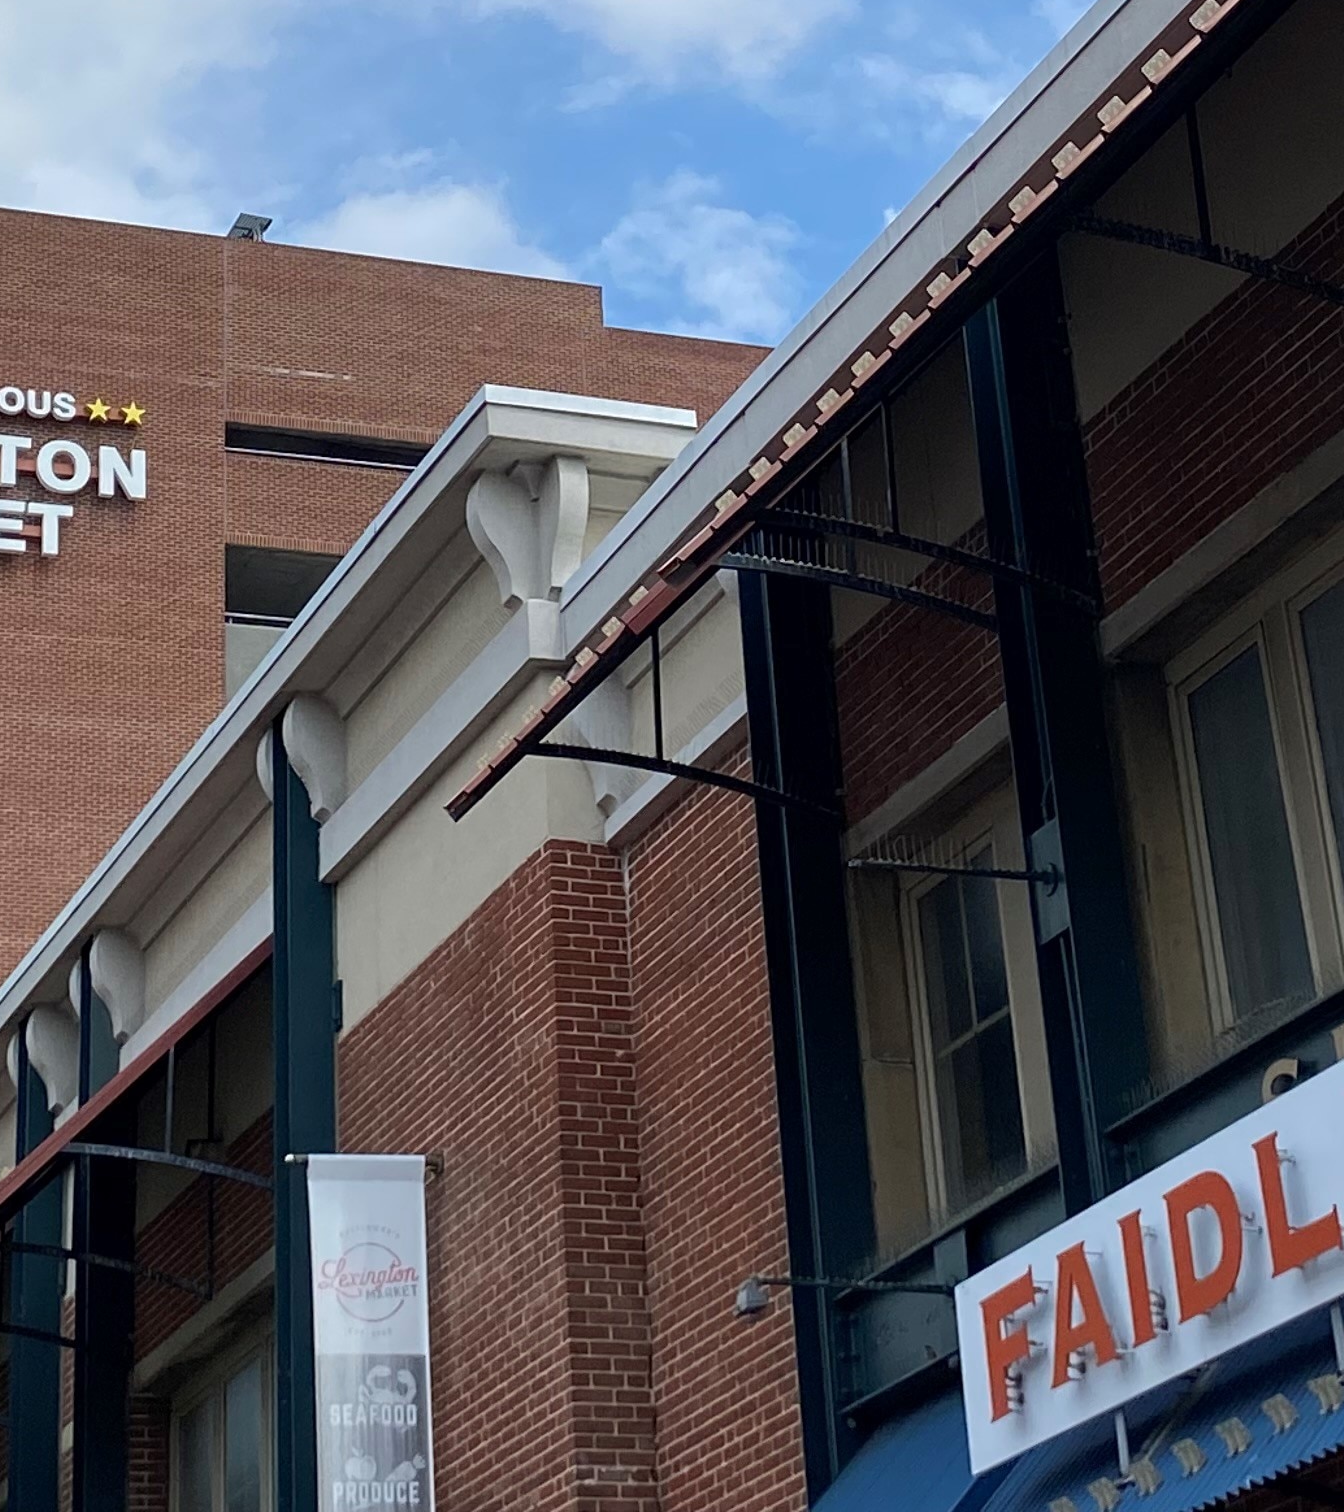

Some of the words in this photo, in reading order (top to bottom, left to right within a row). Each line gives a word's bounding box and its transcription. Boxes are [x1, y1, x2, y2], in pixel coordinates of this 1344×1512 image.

[317, 1256, 419, 1298] Lexington
[330, 1403, 417, 1427] SEAFOOD
[332, 1481, 420, 1507] PRODUCE
